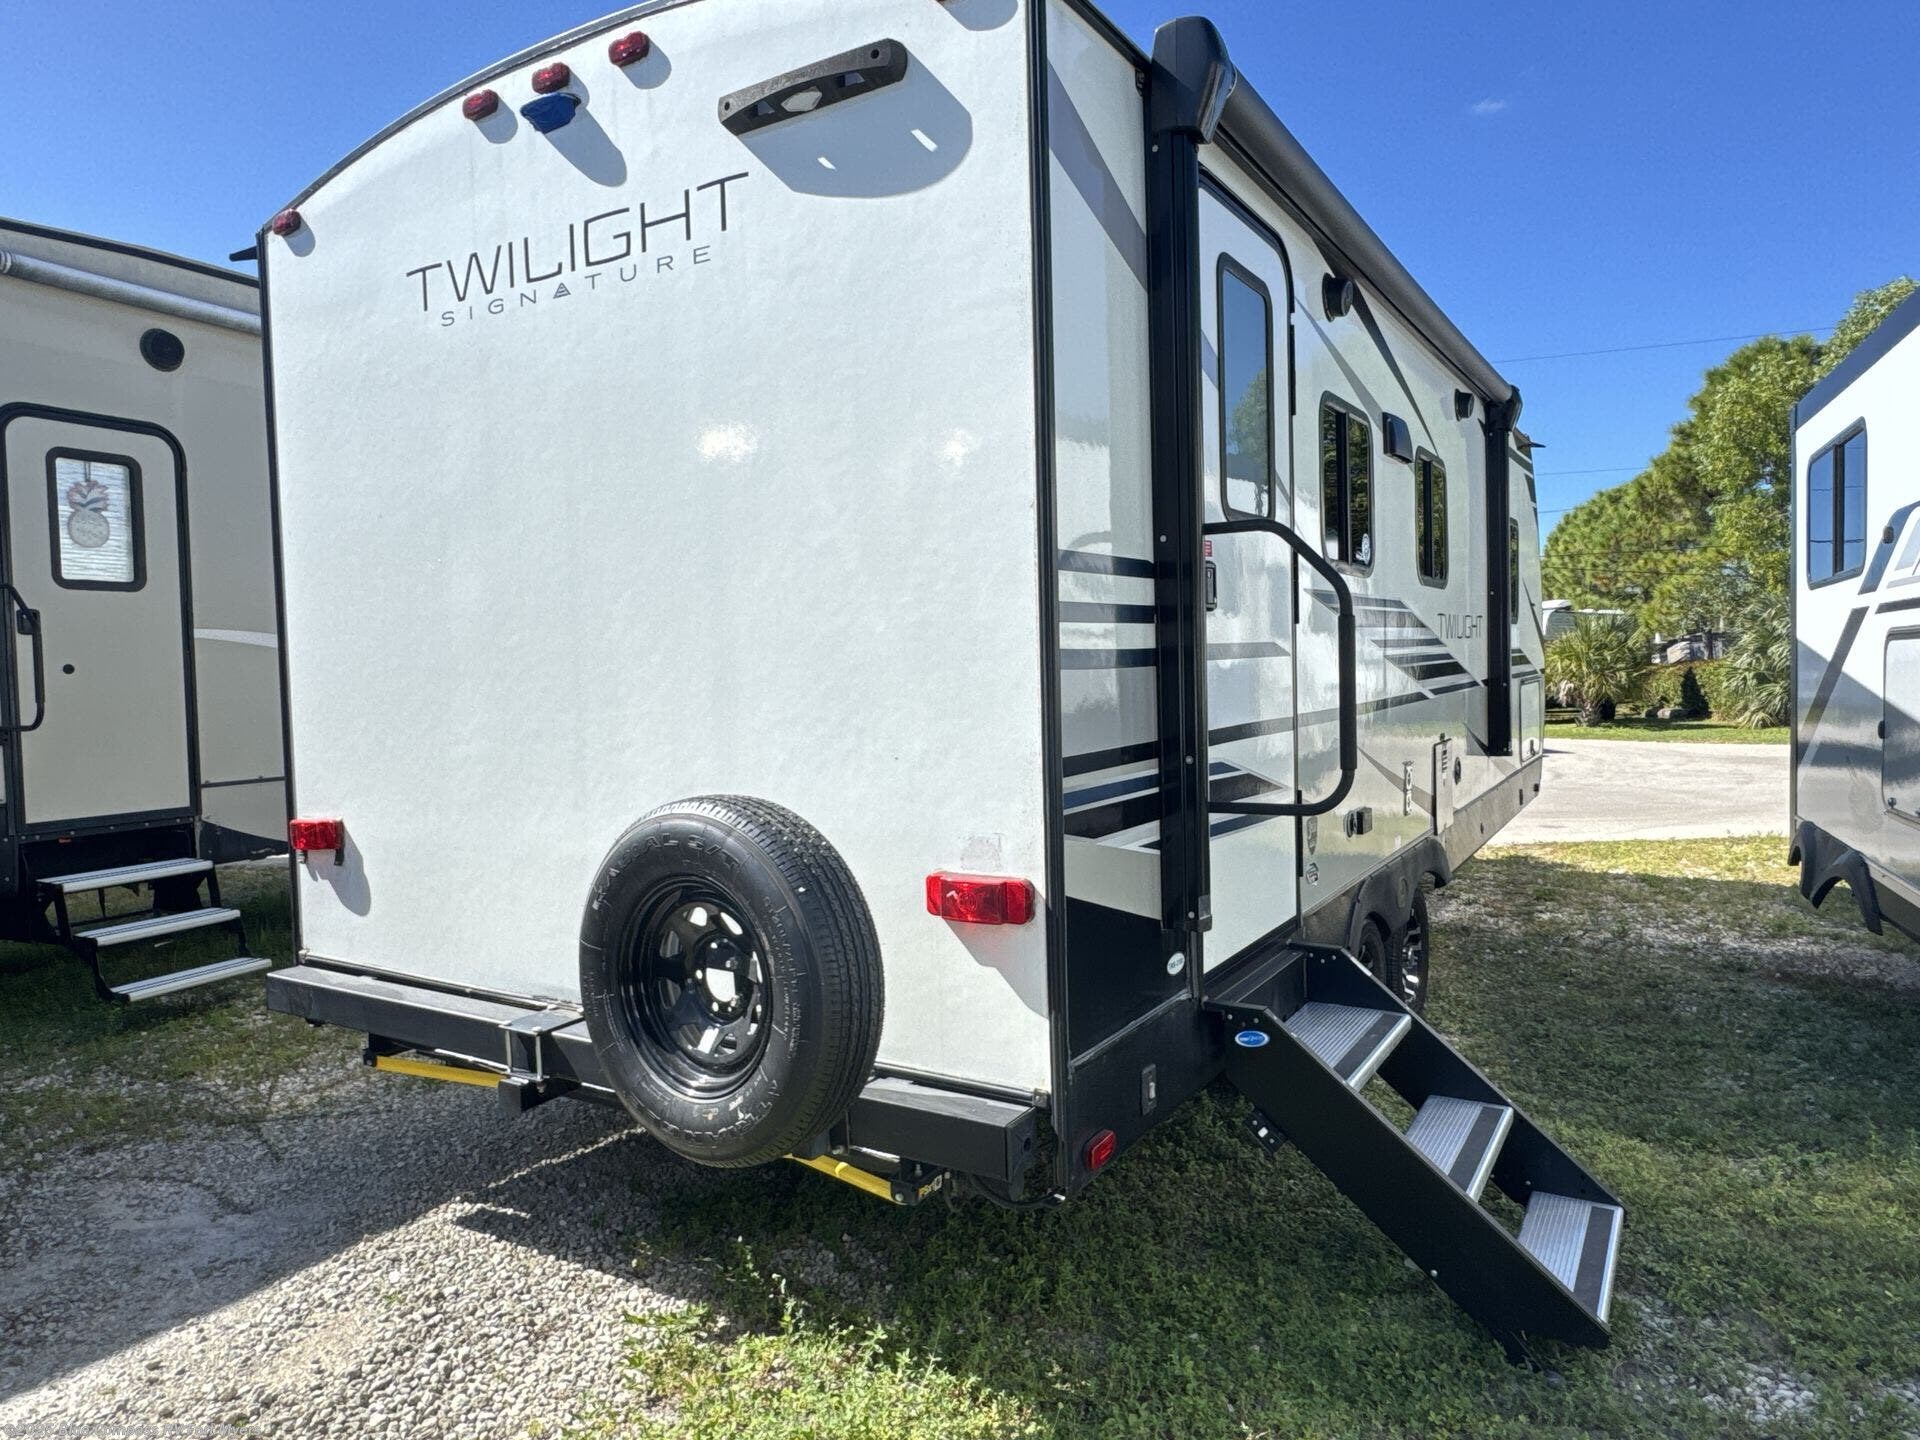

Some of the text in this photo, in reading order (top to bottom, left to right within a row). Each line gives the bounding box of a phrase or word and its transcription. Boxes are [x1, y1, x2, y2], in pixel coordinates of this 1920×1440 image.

[406, 171, 749, 312] TWILIGHT
[440, 245, 712, 327] SIGNATURE
[1437, 612, 1483, 640] TWILIGHT
